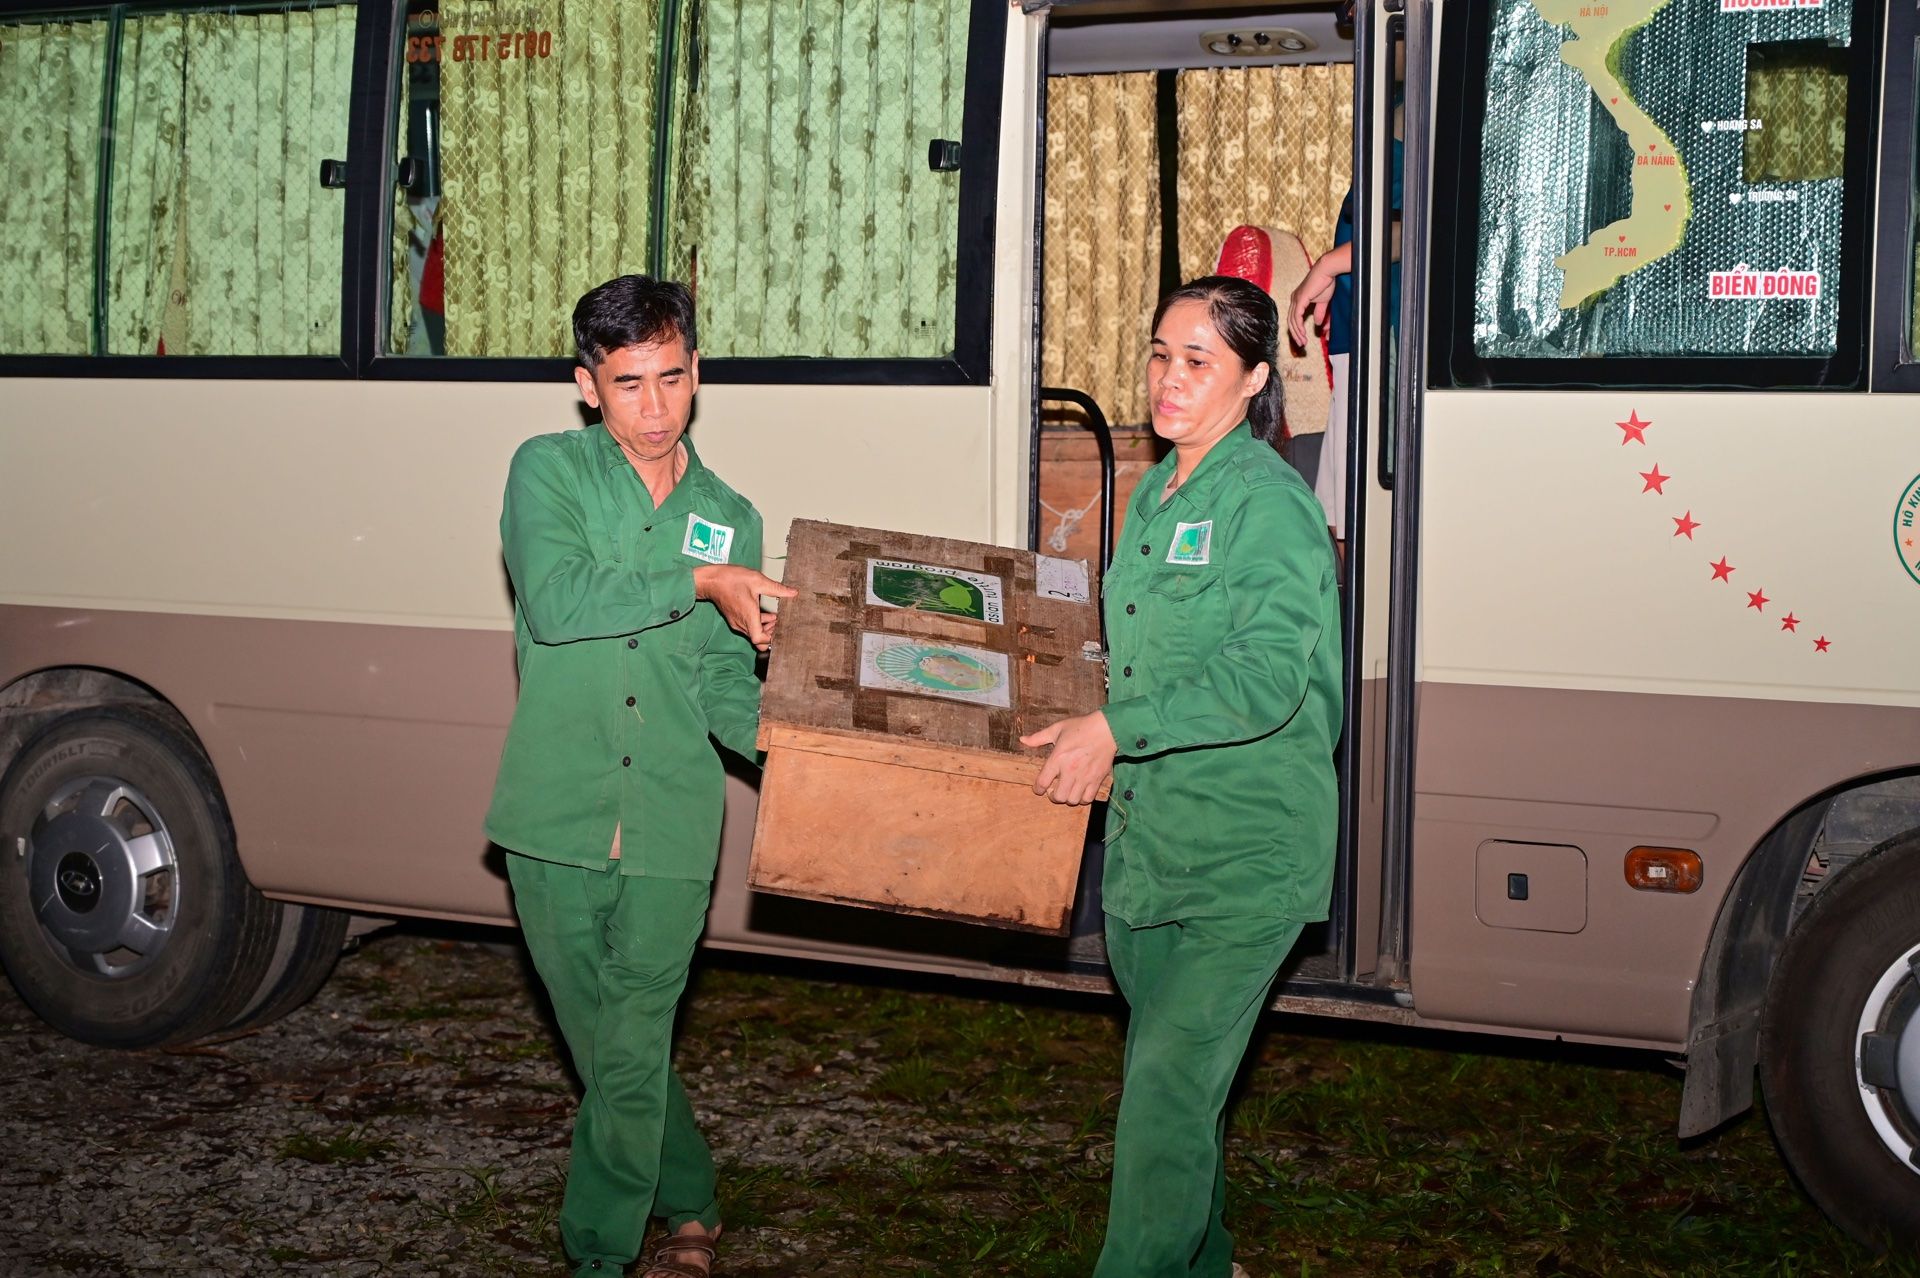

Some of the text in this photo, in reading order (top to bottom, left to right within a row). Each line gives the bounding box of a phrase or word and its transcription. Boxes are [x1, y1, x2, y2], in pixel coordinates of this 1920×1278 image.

[1750, 119, 1763, 130] SA
[1785, 189, 1799, 202] SA
[1604, 247, 1637, 257] TP.HCM
[1712, 265, 1817, 296] BIỂN ĐÔNG
[876, 561, 957, 576] program
[988, 602, 1000, 623] asian
